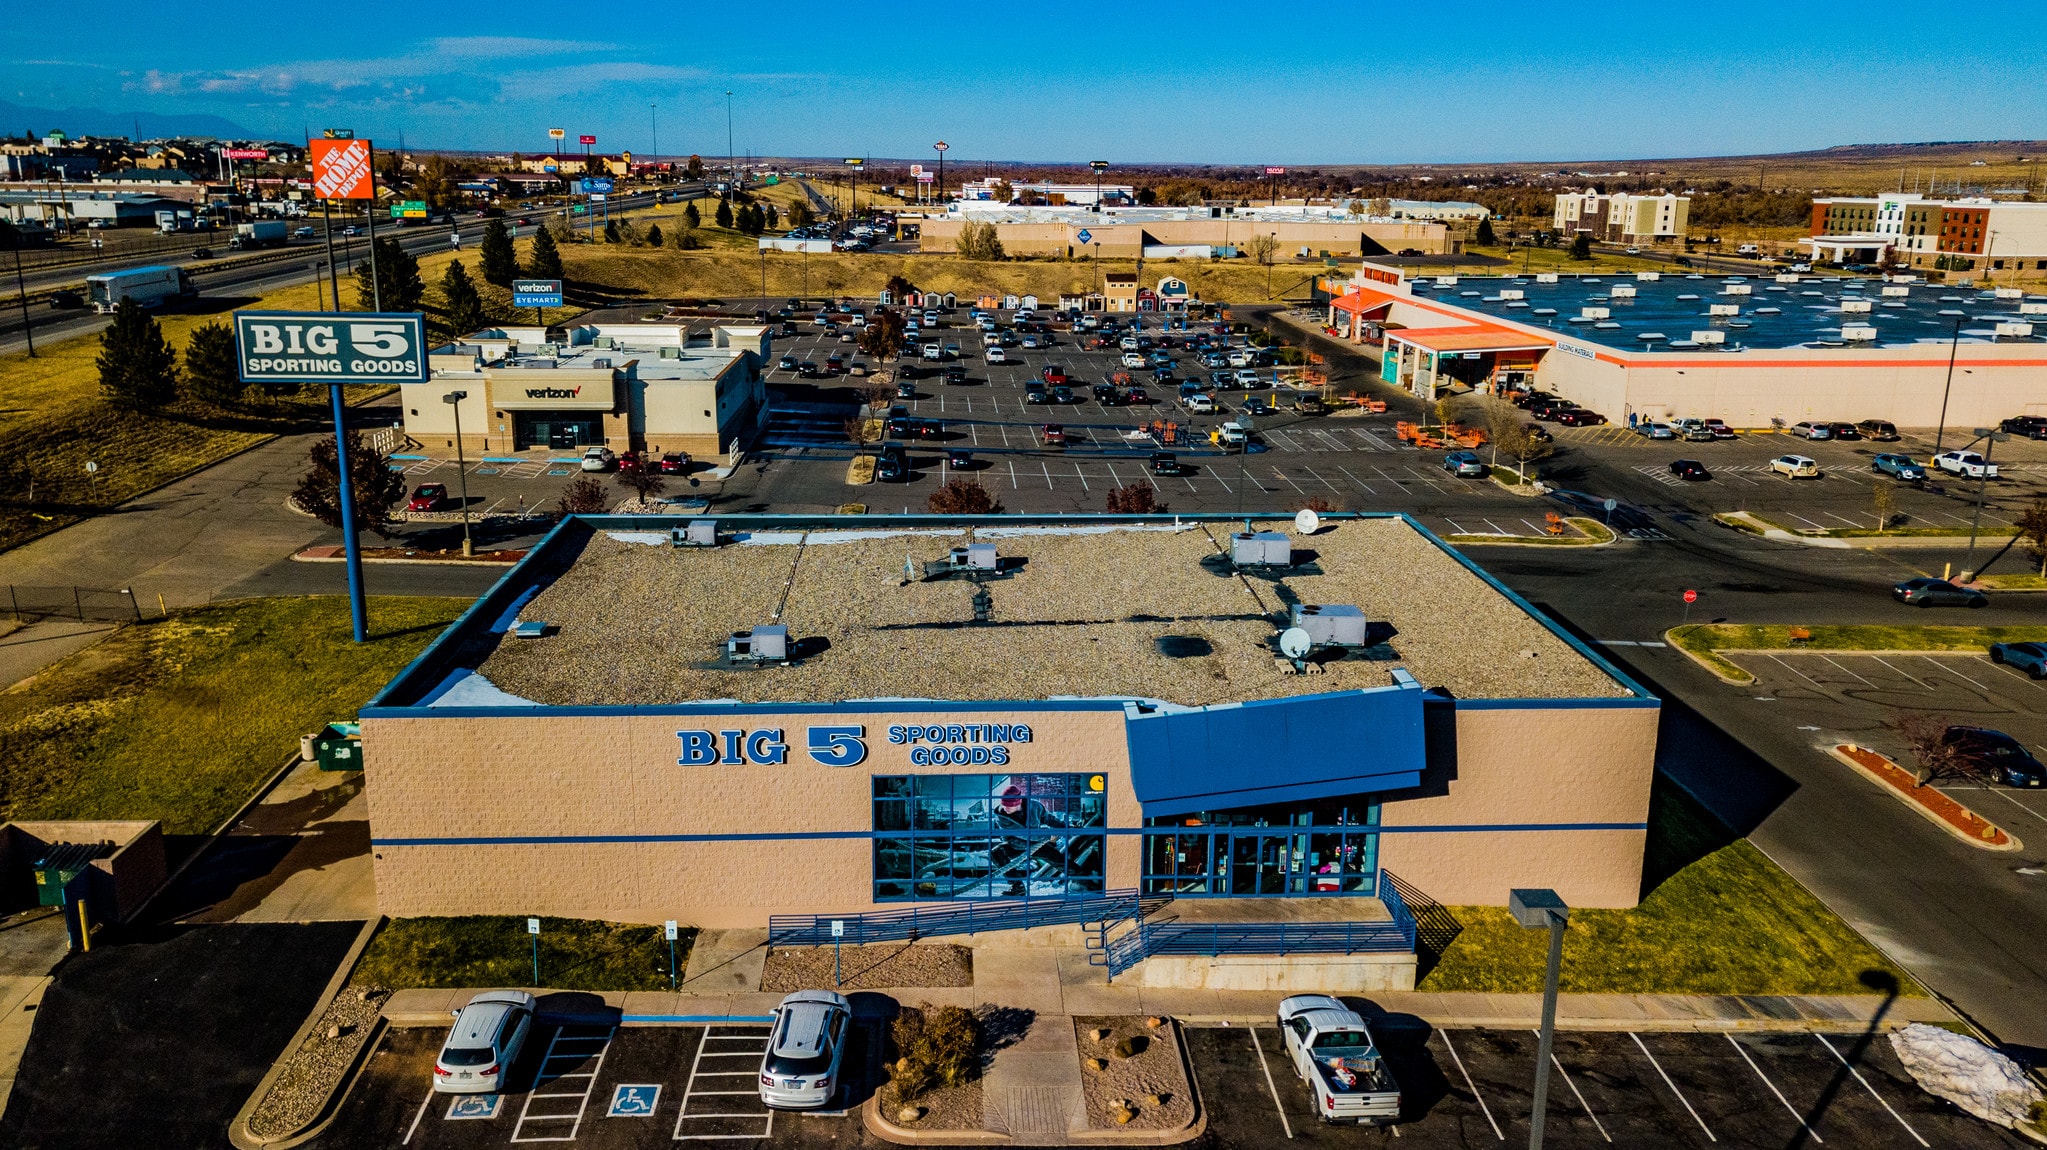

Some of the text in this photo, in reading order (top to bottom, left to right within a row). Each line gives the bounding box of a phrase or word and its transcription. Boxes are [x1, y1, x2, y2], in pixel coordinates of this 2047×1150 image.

[315, 140, 369, 198] HOME
[319, 147, 341, 170] THE
[338, 161, 371, 198] DEPOT
[518, 283, 552, 292] verizon
[250, 324, 409, 358] BIG 5
[249, 359, 417, 373] SPORTING GOODS
[525, 387, 576, 398] verizon
[888, 725, 1030, 744] SPORTING
[676, 725, 866, 766] BIG 5
[910, 746, 1007, 765] GOODS
